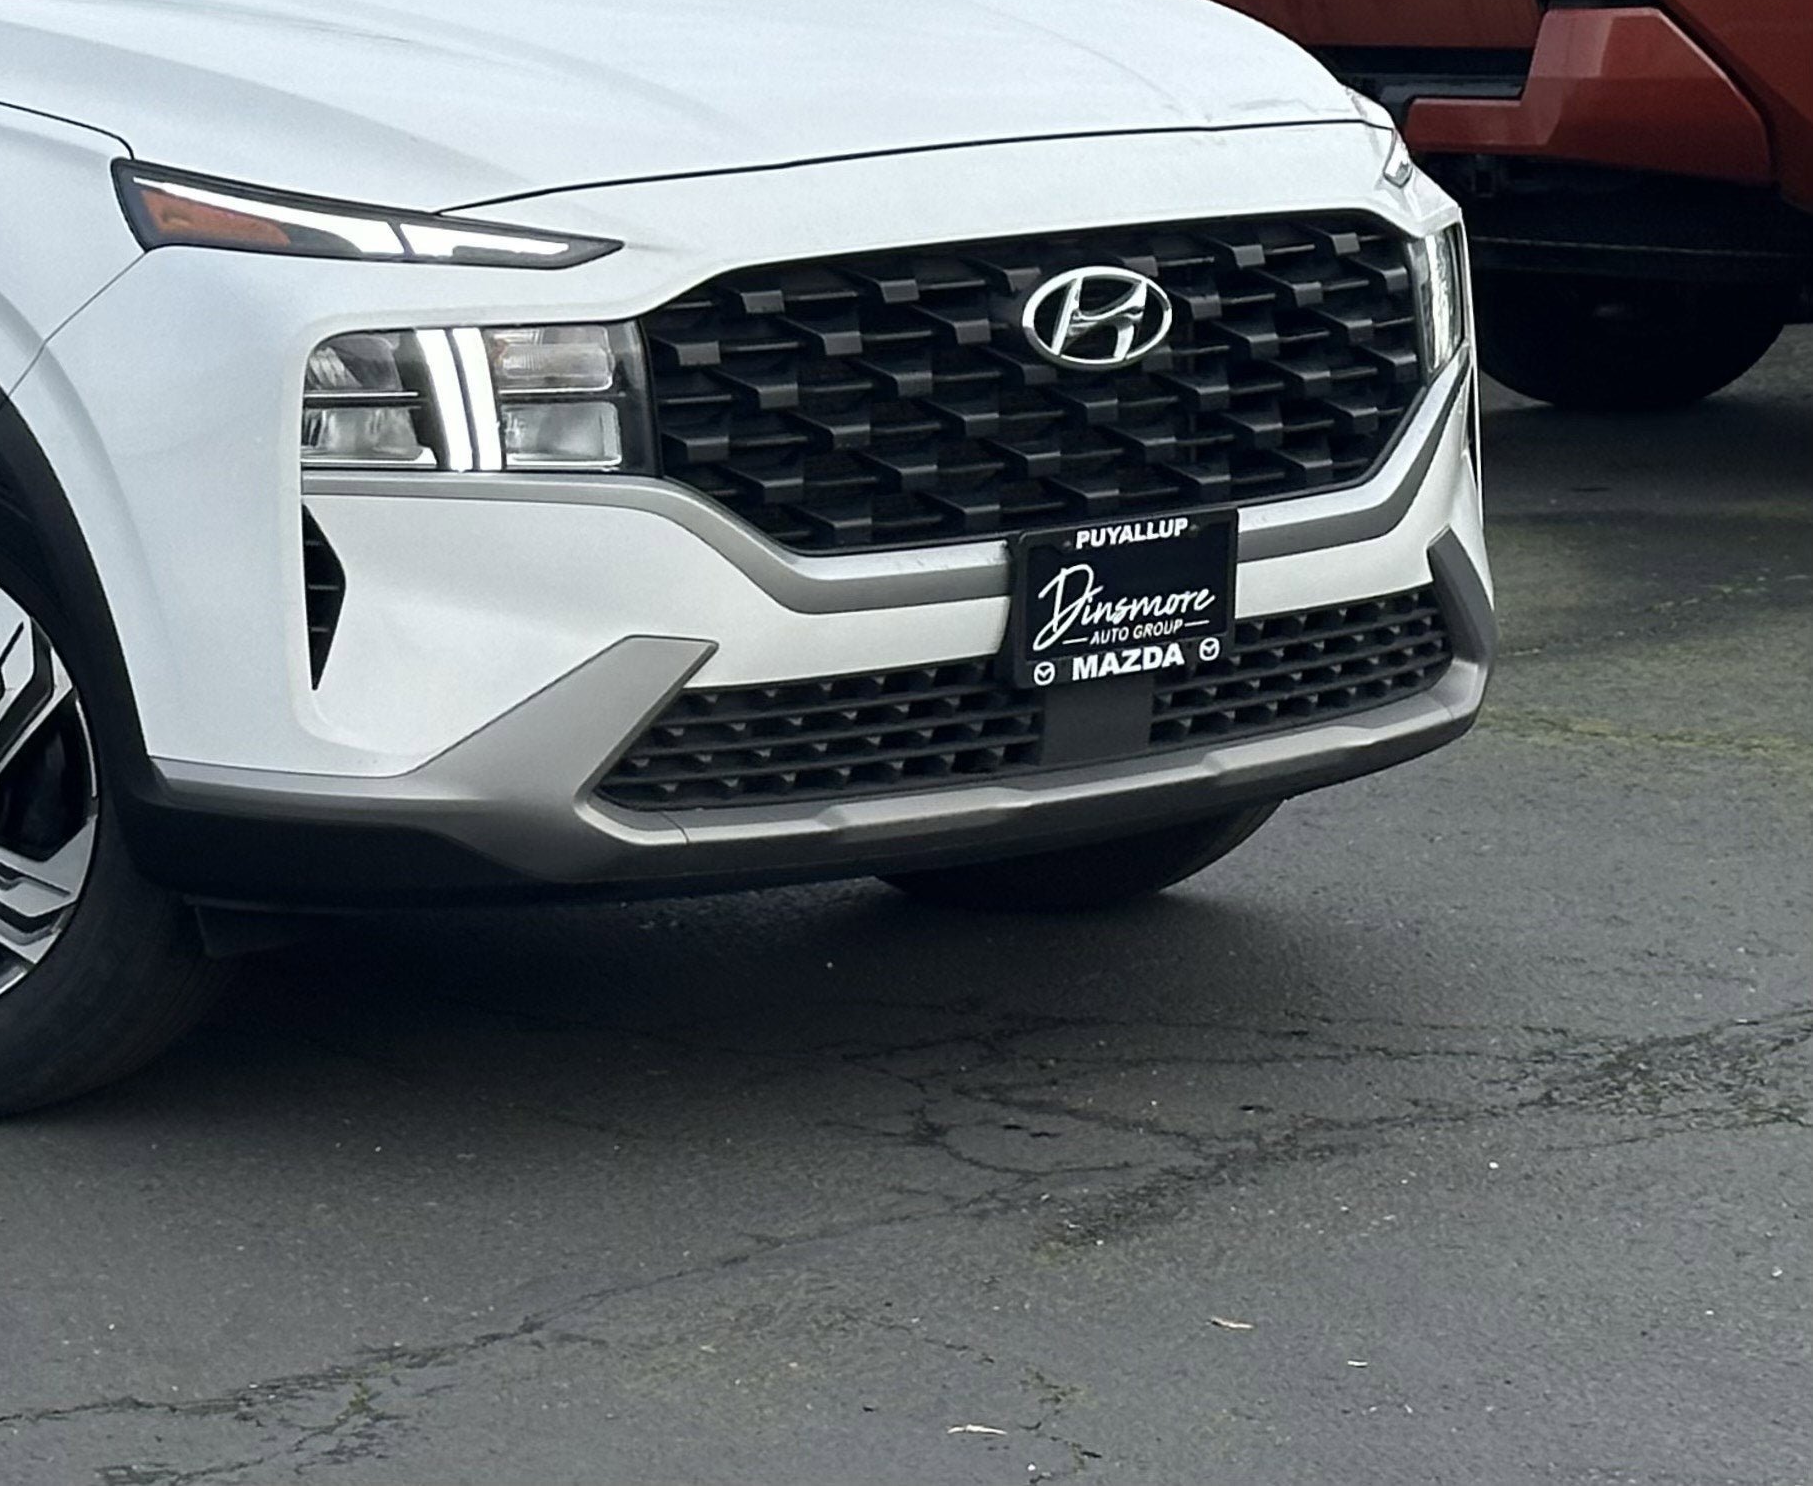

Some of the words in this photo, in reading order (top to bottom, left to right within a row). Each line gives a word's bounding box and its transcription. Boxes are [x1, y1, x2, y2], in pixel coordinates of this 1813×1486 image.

[1076, 518, 1188, 549] PUYALLUP
[1033, 564, 1215, 651] Dinsmore
[1090, 627, 1129, 646] AUTO
[1133, 619, 1183, 639] GROUP
[1072, 643, 1185, 681] MAZDA
